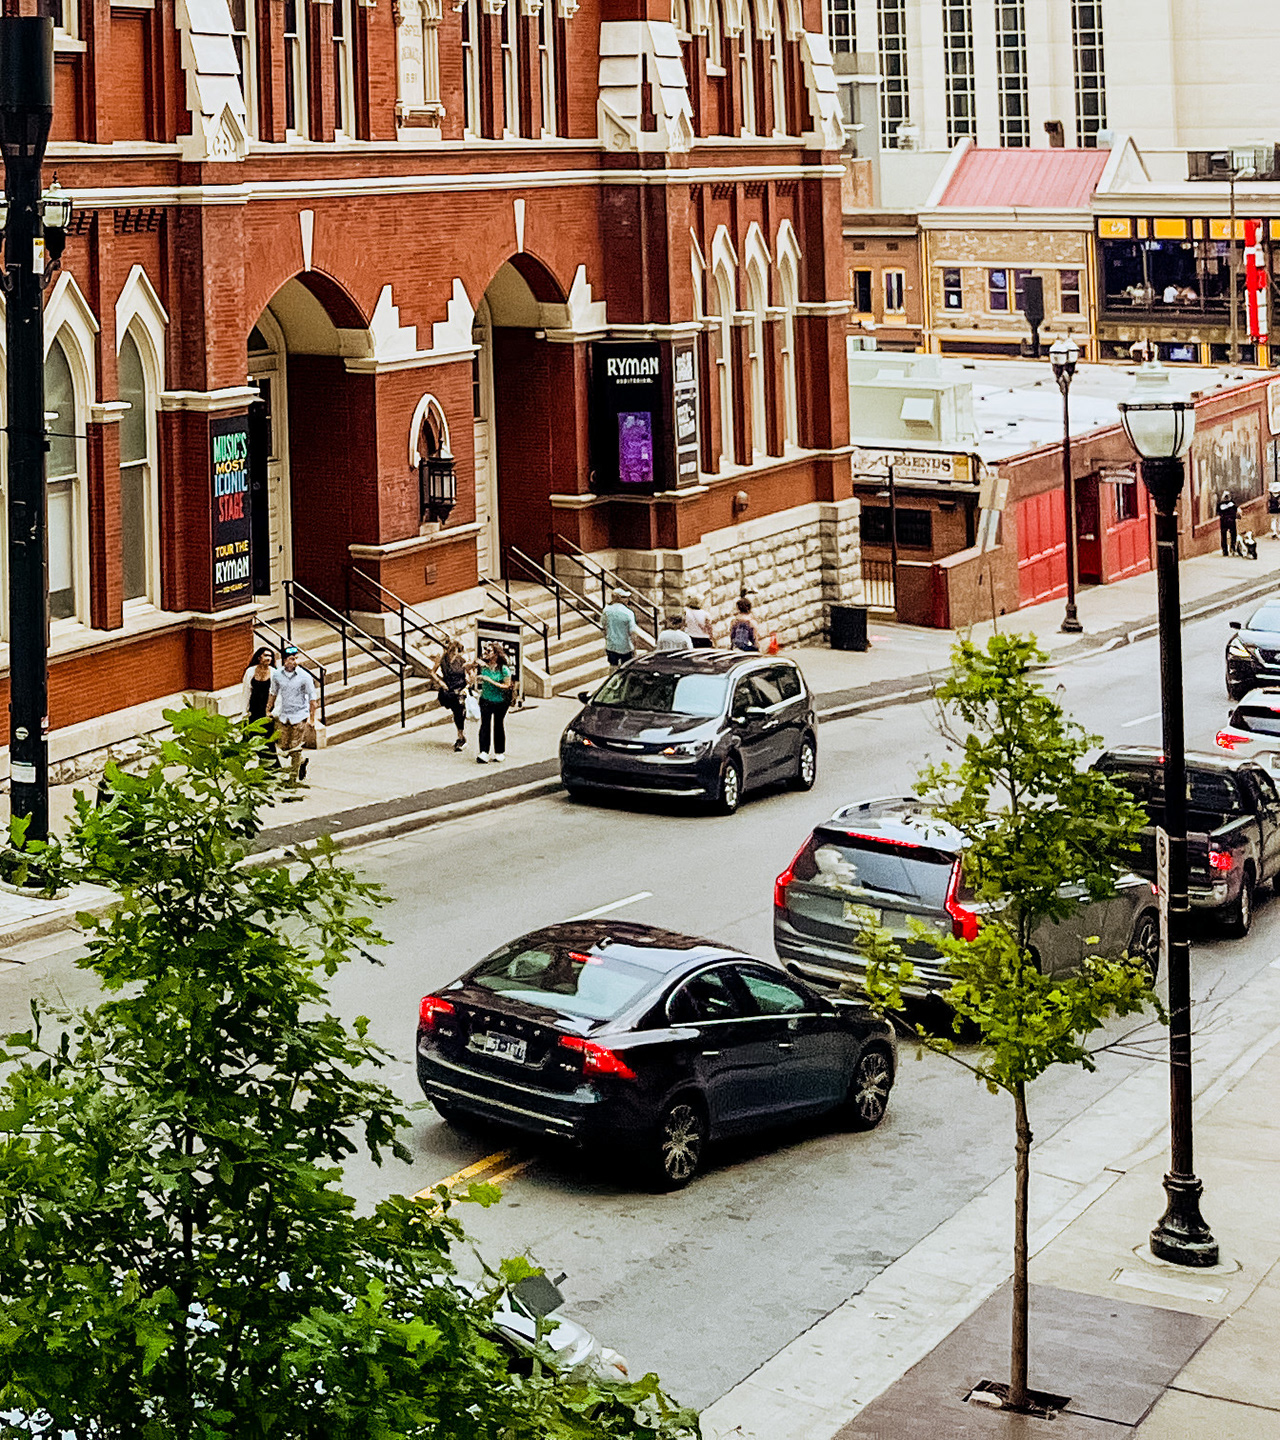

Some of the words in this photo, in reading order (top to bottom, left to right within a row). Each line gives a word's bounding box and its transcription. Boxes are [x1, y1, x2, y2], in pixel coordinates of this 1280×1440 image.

[607, 357, 659, 376] RYMAN
[213, 432, 247, 464] MUSIC'S
[215, 458, 246, 475] MOST
[883, 455, 951, 472] LEGENDS
[214, 468, 248, 498] ICONIC
[218, 492, 245, 522] STAGE
[215, 543, 234, 558] TOUR
[234, 539, 249, 553] THE
[215, 555, 249, 585] RYMAN
